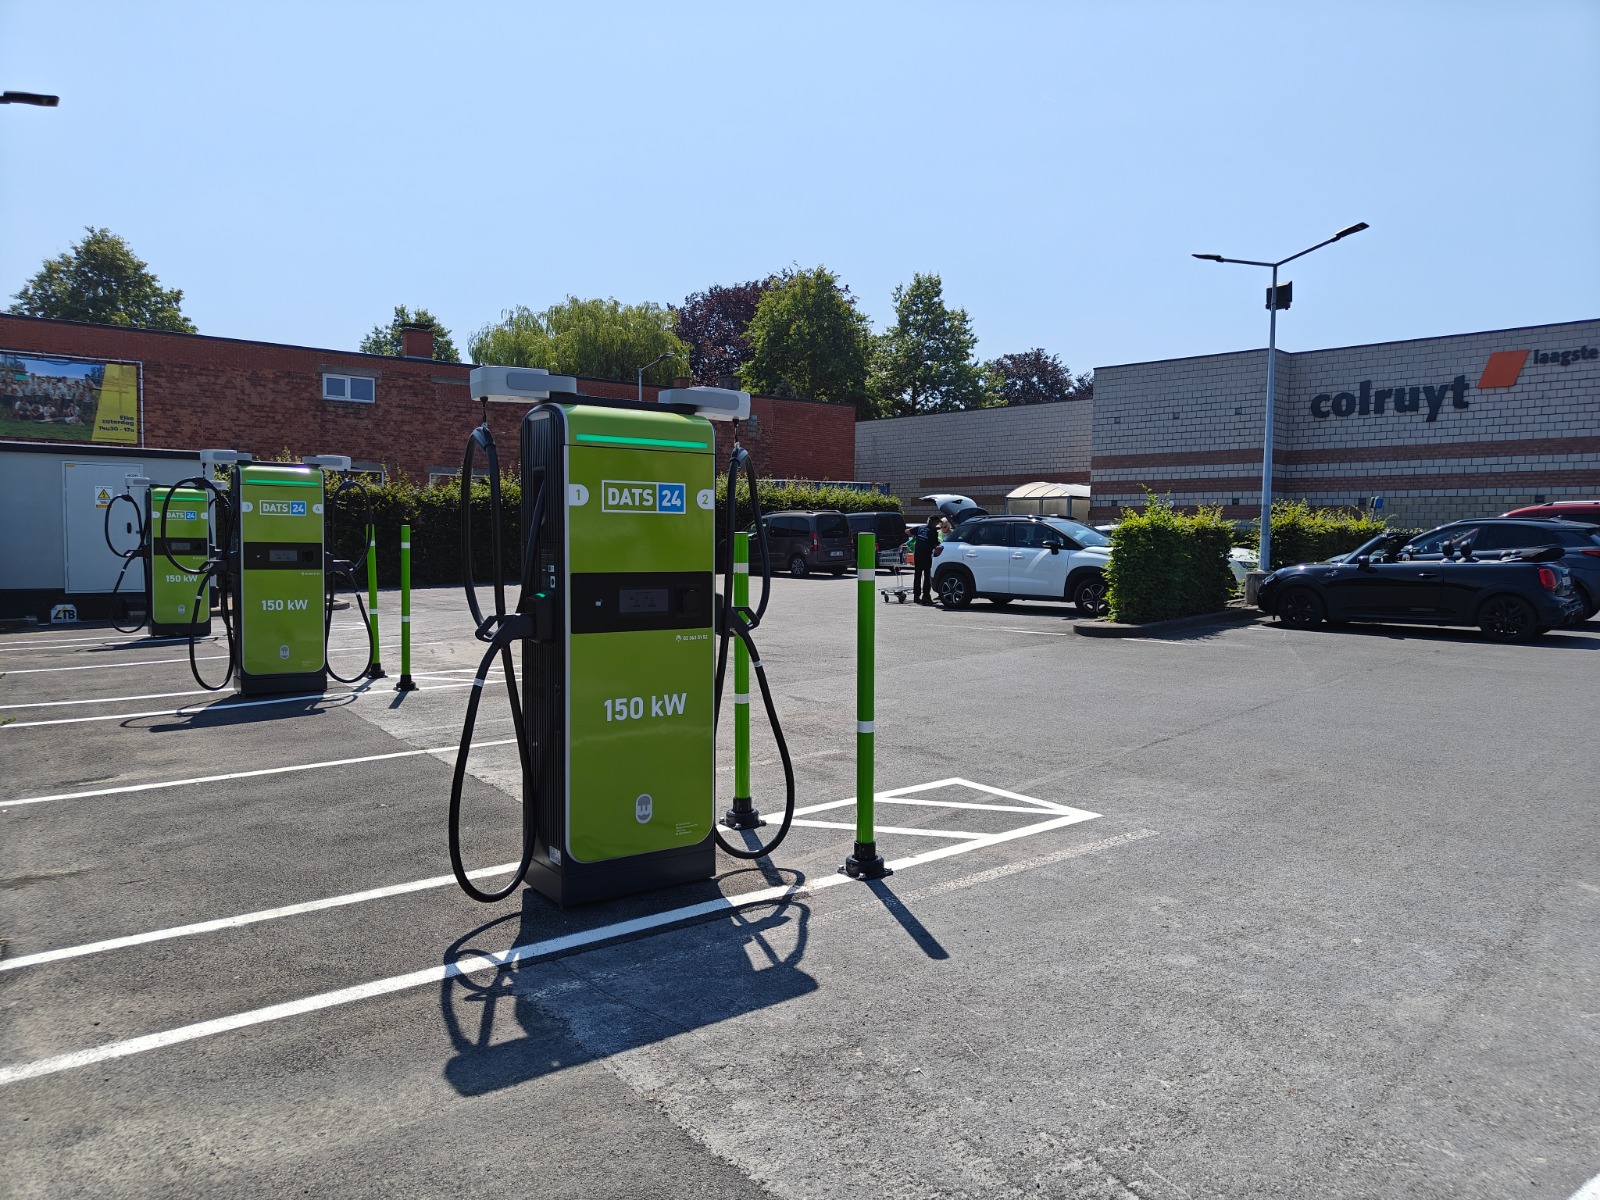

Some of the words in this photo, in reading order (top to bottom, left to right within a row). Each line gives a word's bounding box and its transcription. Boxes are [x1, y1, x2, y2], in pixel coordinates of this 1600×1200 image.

[1534, 345, 1599, 366] laagste
[1311, 374, 1470, 422] colruyt
[607, 487, 654, 506] DATS
[661, 489, 682, 507] 24
[702, 494, 709, 505] 2
[262, 503, 289, 513] DATS
[292, 504, 305, 513] 24
[166, 511, 185, 519] DATS
[165, 574, 182, 583] 150
[183, 574, 199, 583] kW
[261, 599, 284, 611] 150
[287, 599, 308, 611] kW
[604, 696, 644, 722] 150
[651, 692, 687, 718] kW
